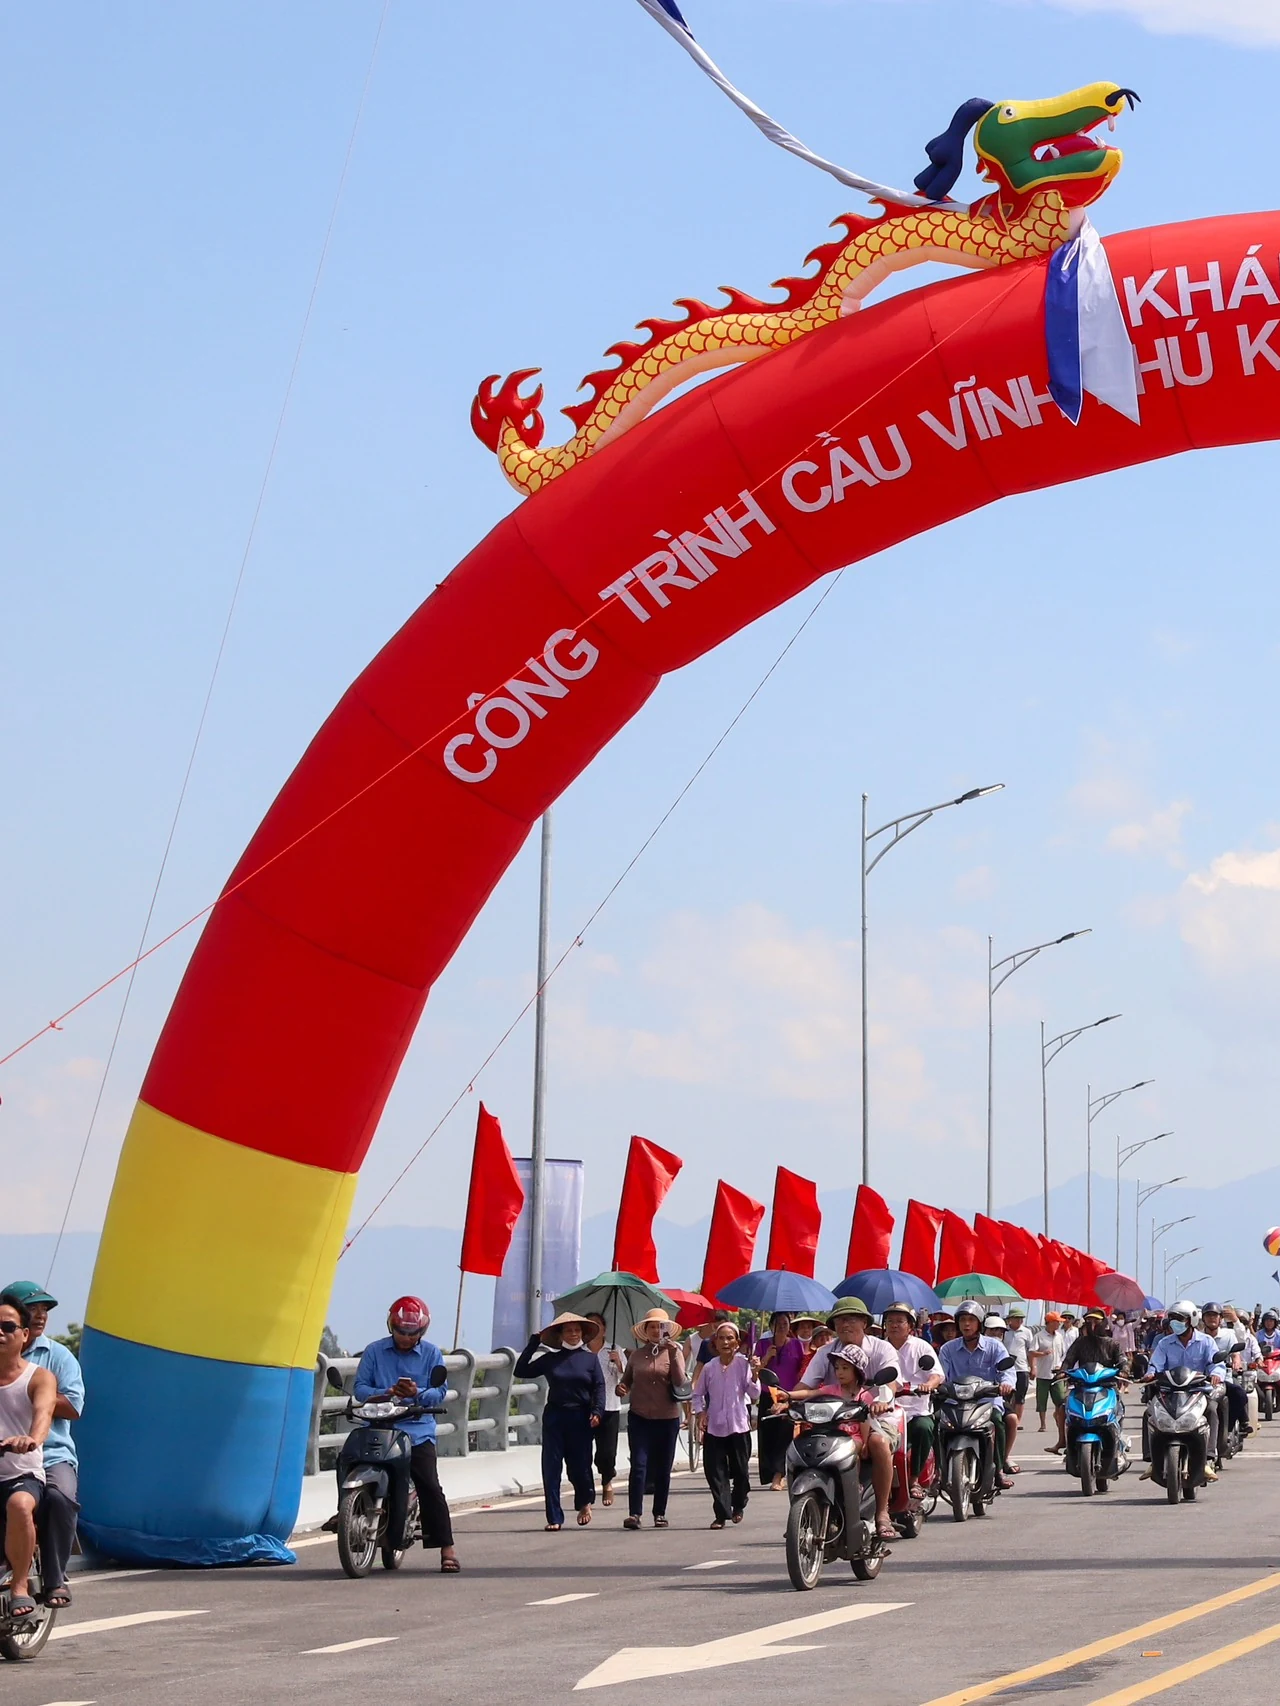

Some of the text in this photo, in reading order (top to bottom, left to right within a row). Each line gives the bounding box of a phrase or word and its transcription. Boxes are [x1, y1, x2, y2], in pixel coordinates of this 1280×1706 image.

[443, 628, 599, 783] CÔNG
[598, 489, 777, 623] TRÌNH
[781, 431, 912, 513] CẦU
[1098, 318, 1214, 406] HÚ
